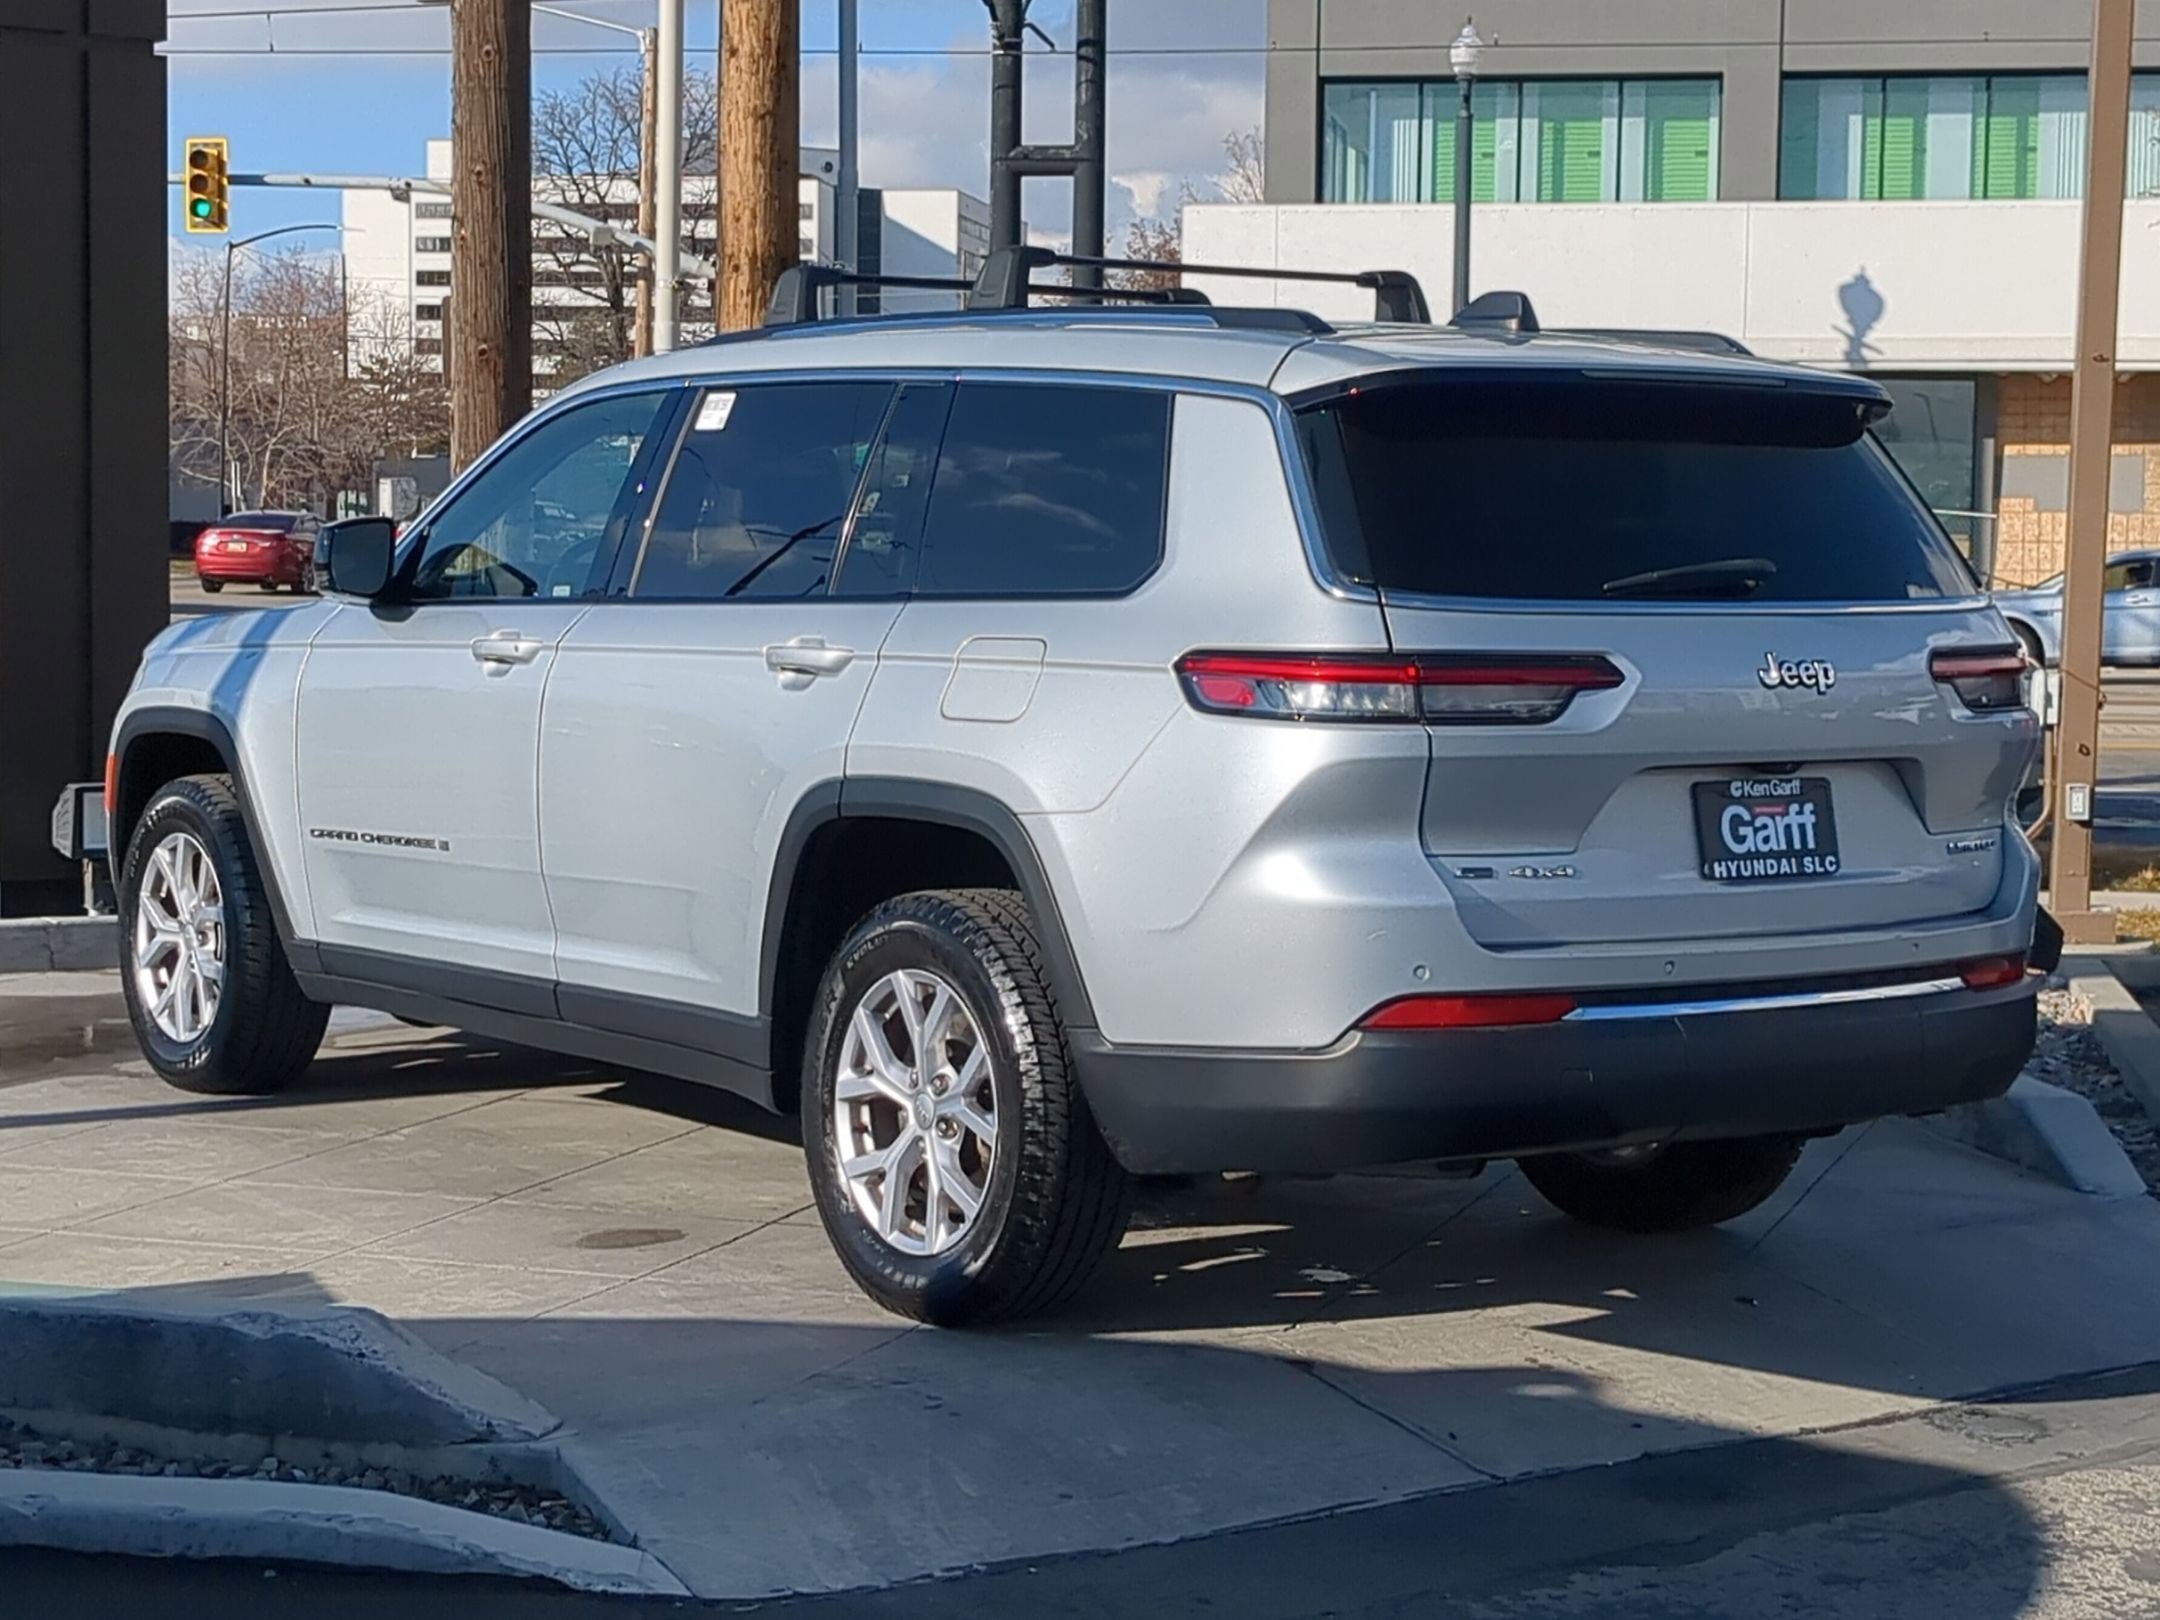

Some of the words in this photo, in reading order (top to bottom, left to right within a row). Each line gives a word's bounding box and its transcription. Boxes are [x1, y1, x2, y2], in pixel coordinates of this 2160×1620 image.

[1758, 652, 1836, 694] Jeep
[1721, 802, 1816, 854] Garff
[1713, 857, 1798, 878] HYUNDAI
[1802, 855, 1837, 874] SLC
